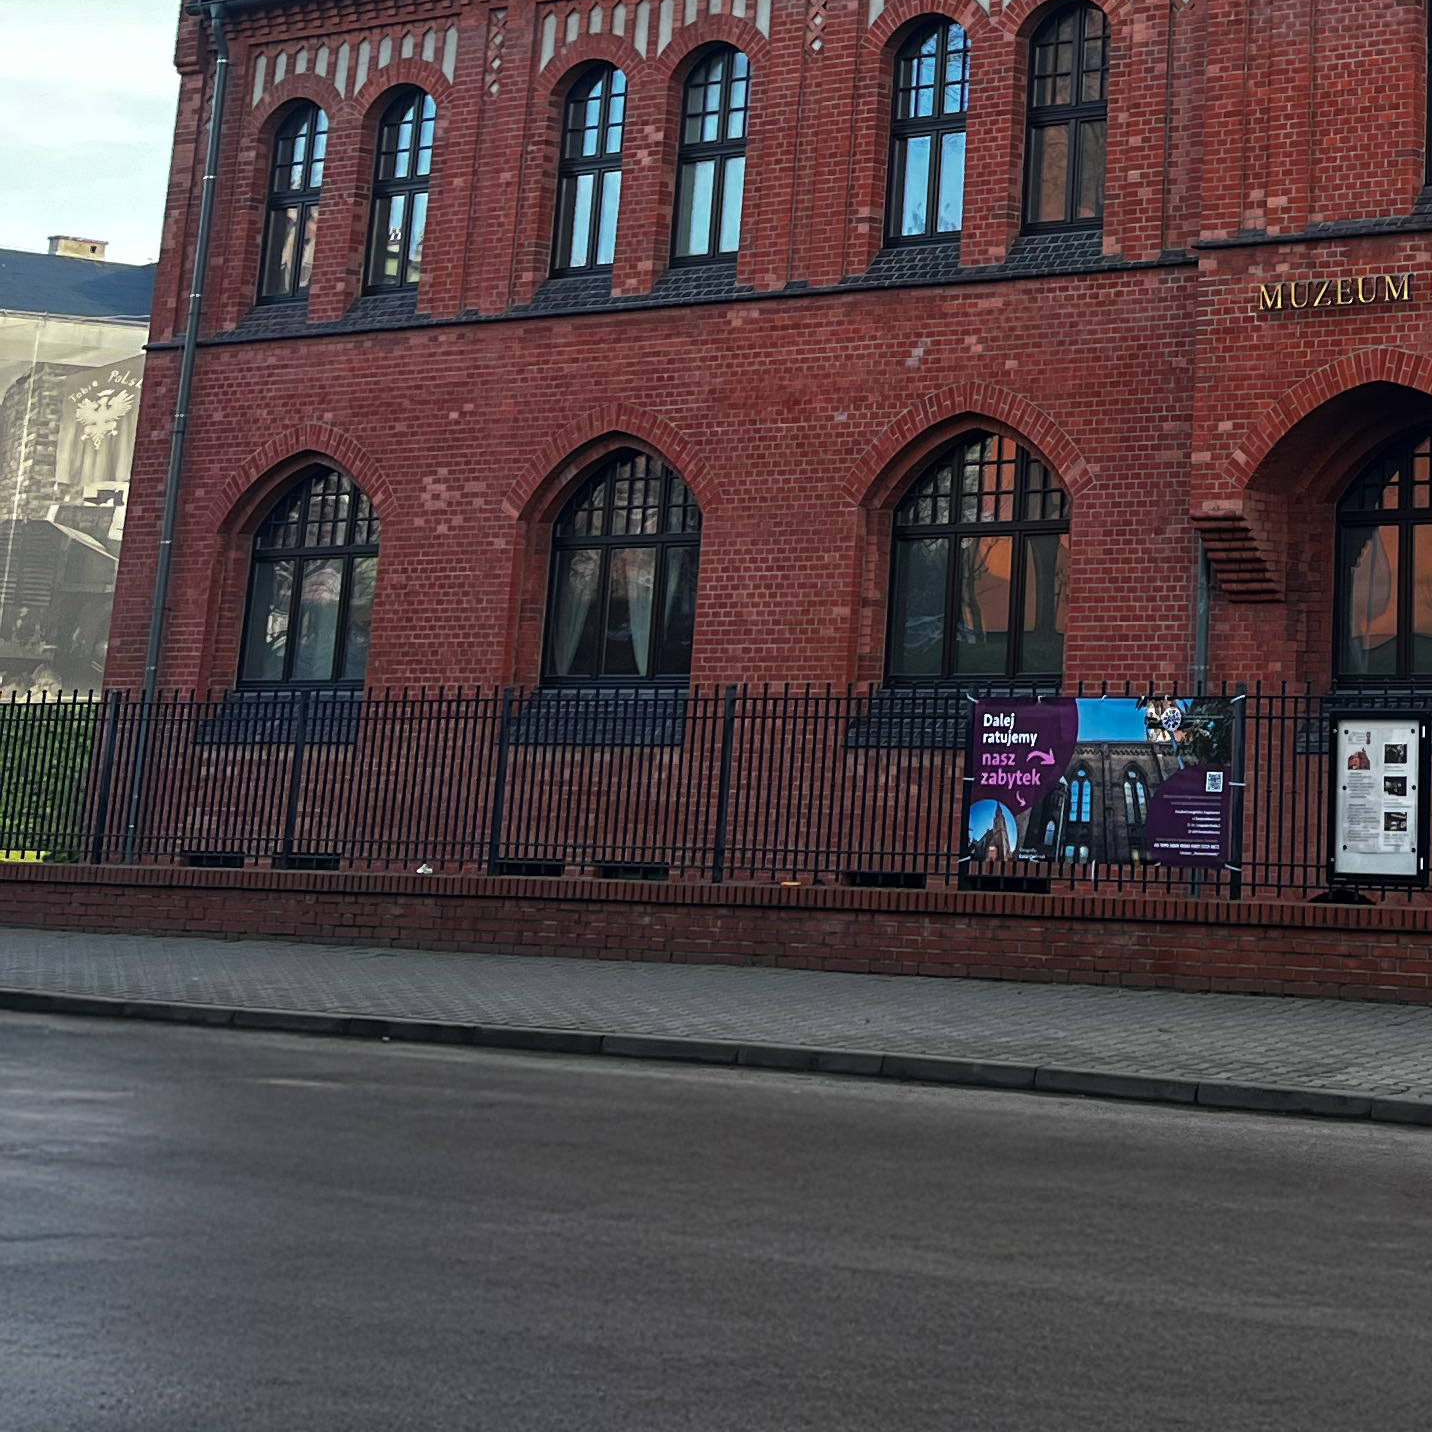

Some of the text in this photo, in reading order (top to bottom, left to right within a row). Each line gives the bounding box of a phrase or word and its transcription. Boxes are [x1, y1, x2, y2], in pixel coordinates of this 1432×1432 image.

[1259, 273, 1412, 310] MUZEUM
[983, 712, 1015, 729] Dalej
[983, 729, 1038, 747] ratujemy
[982, 753, 1016, 766] nasz
[981, 768, 1041, 789] zabytek
